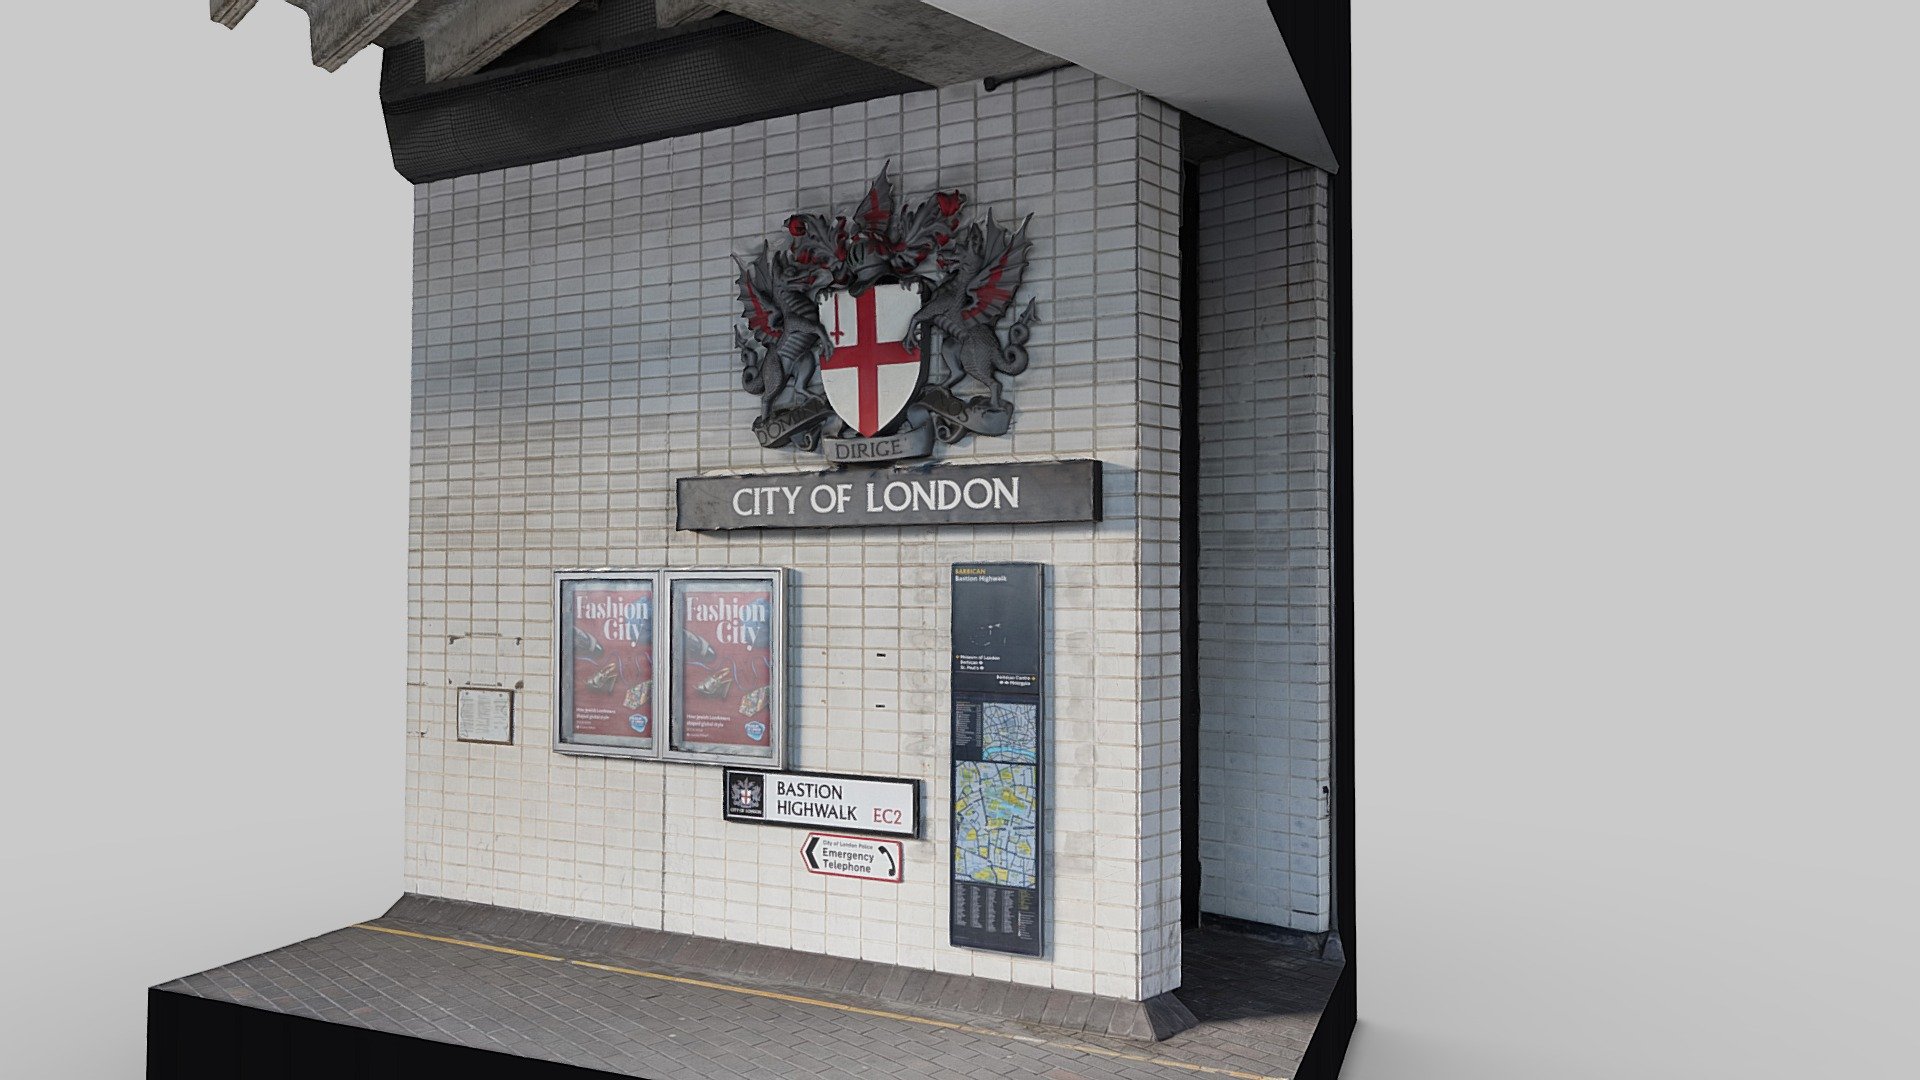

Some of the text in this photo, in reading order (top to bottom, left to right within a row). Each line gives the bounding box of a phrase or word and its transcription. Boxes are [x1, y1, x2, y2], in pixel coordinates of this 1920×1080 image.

[834, 439, 903, 460] DIRIGE
[732, 476, 1020, 516] CITY OF LONDON
[576, 596, 649, 620] Fashion
[685, 597, 766, 622] Fashion
[604, 617, 644, 648] City
[716, 619, 760, 651] City
[777, 781, 843, 800] BASTION
[777, 800, 902, 825] HIGHWALK EC2
[822, 847, 875, 864] Emergency
[840, 841, 857, 849] London
[822, 859, 871, 873] Telephone
